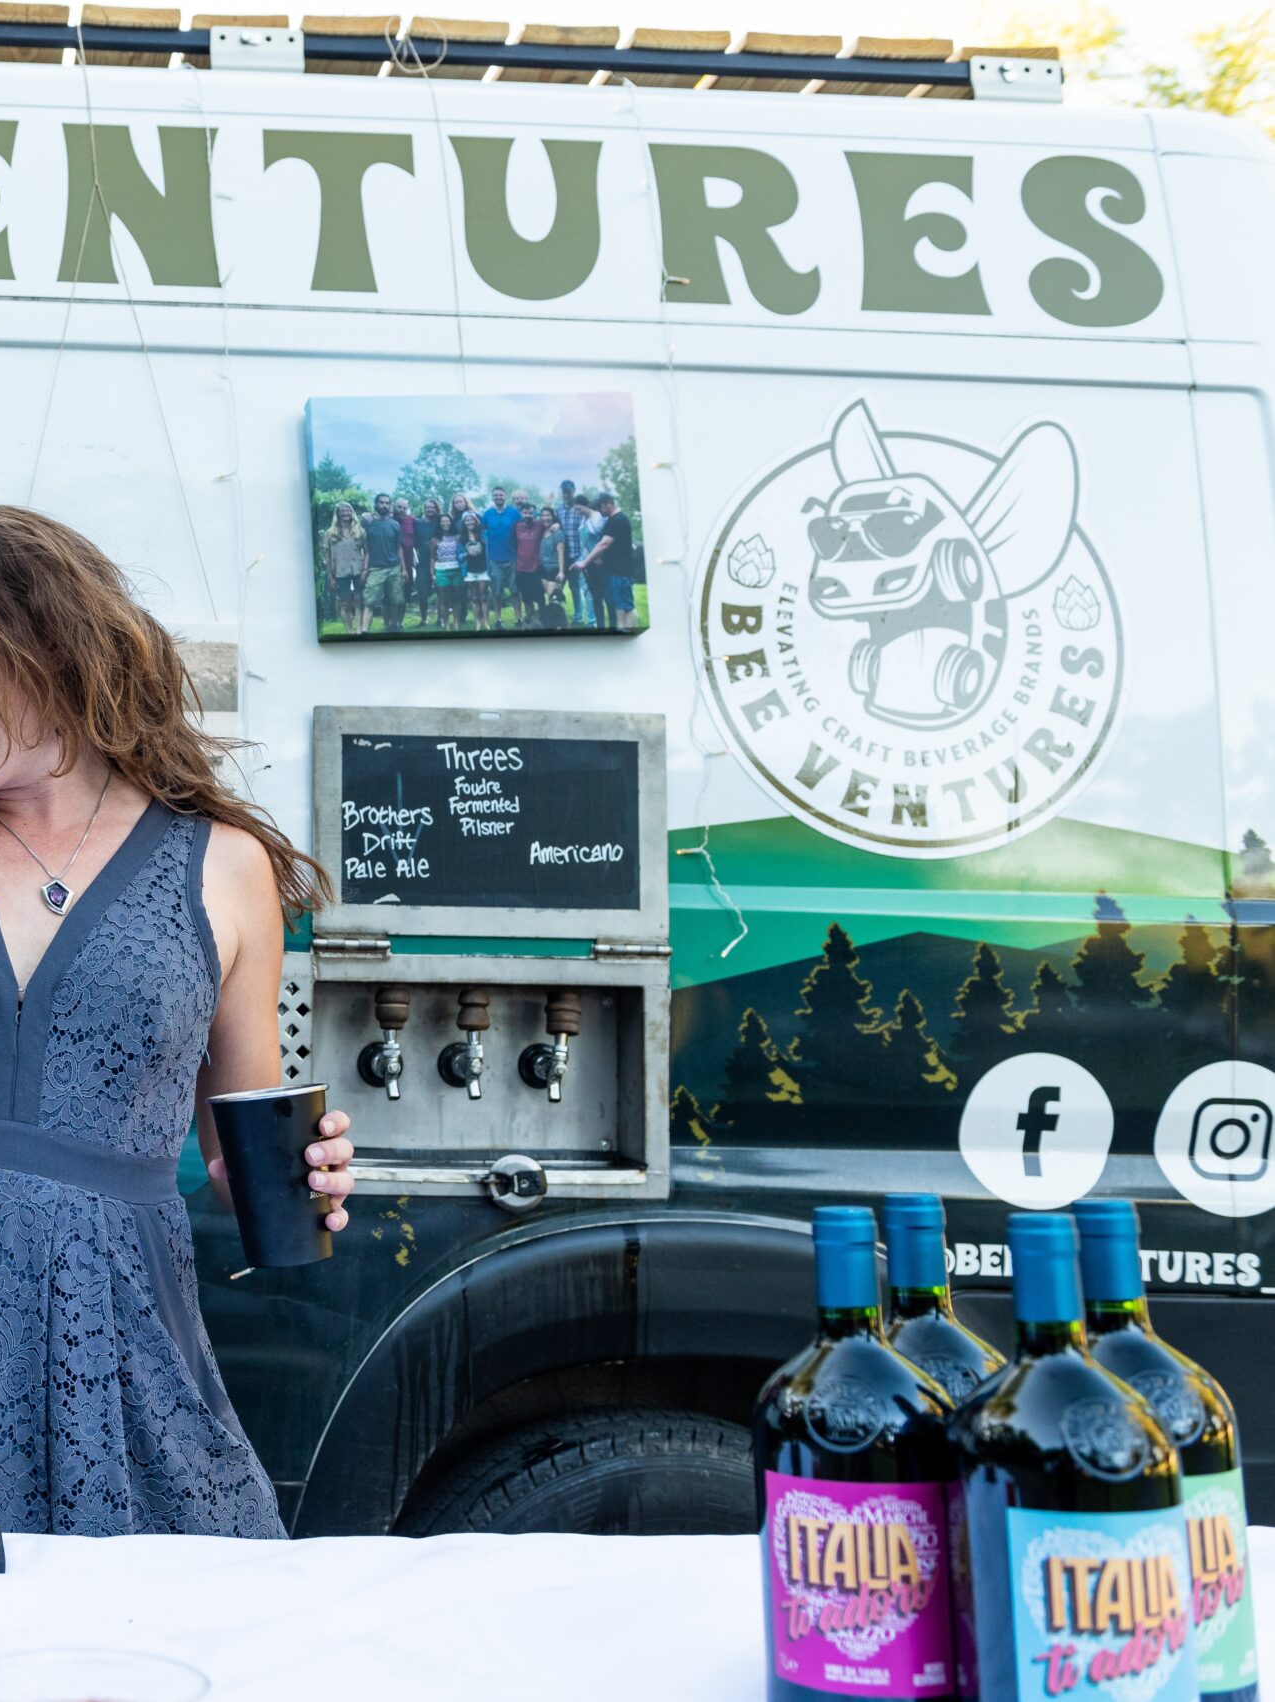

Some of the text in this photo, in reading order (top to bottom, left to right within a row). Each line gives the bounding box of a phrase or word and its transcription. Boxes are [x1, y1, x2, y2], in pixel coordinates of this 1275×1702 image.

[776, 581, 1044, 767] ELEVATING CRAFT BEVERAGE BRANDS
[721, 601, 1105, 828] BEE VENTURES
[437, 743, 524, 771] Threes
[454, 776, 502, 796] Foudre
[342, 801, 434, 831] Brothers
[448, 796, 520, 815] Fermented
[459, 817, 515, 837] Pilsner
[363, 831, 417, 856] Drift
[529, 841, 624, 865] Americano
[345, 857, 430, 880] Pale Ale
[787, 1512, 921, 1590] ITALIA
[1186, 1514, 1238, 1583] LIA
[1045, 1555, 1182, 1634] ITALIA
